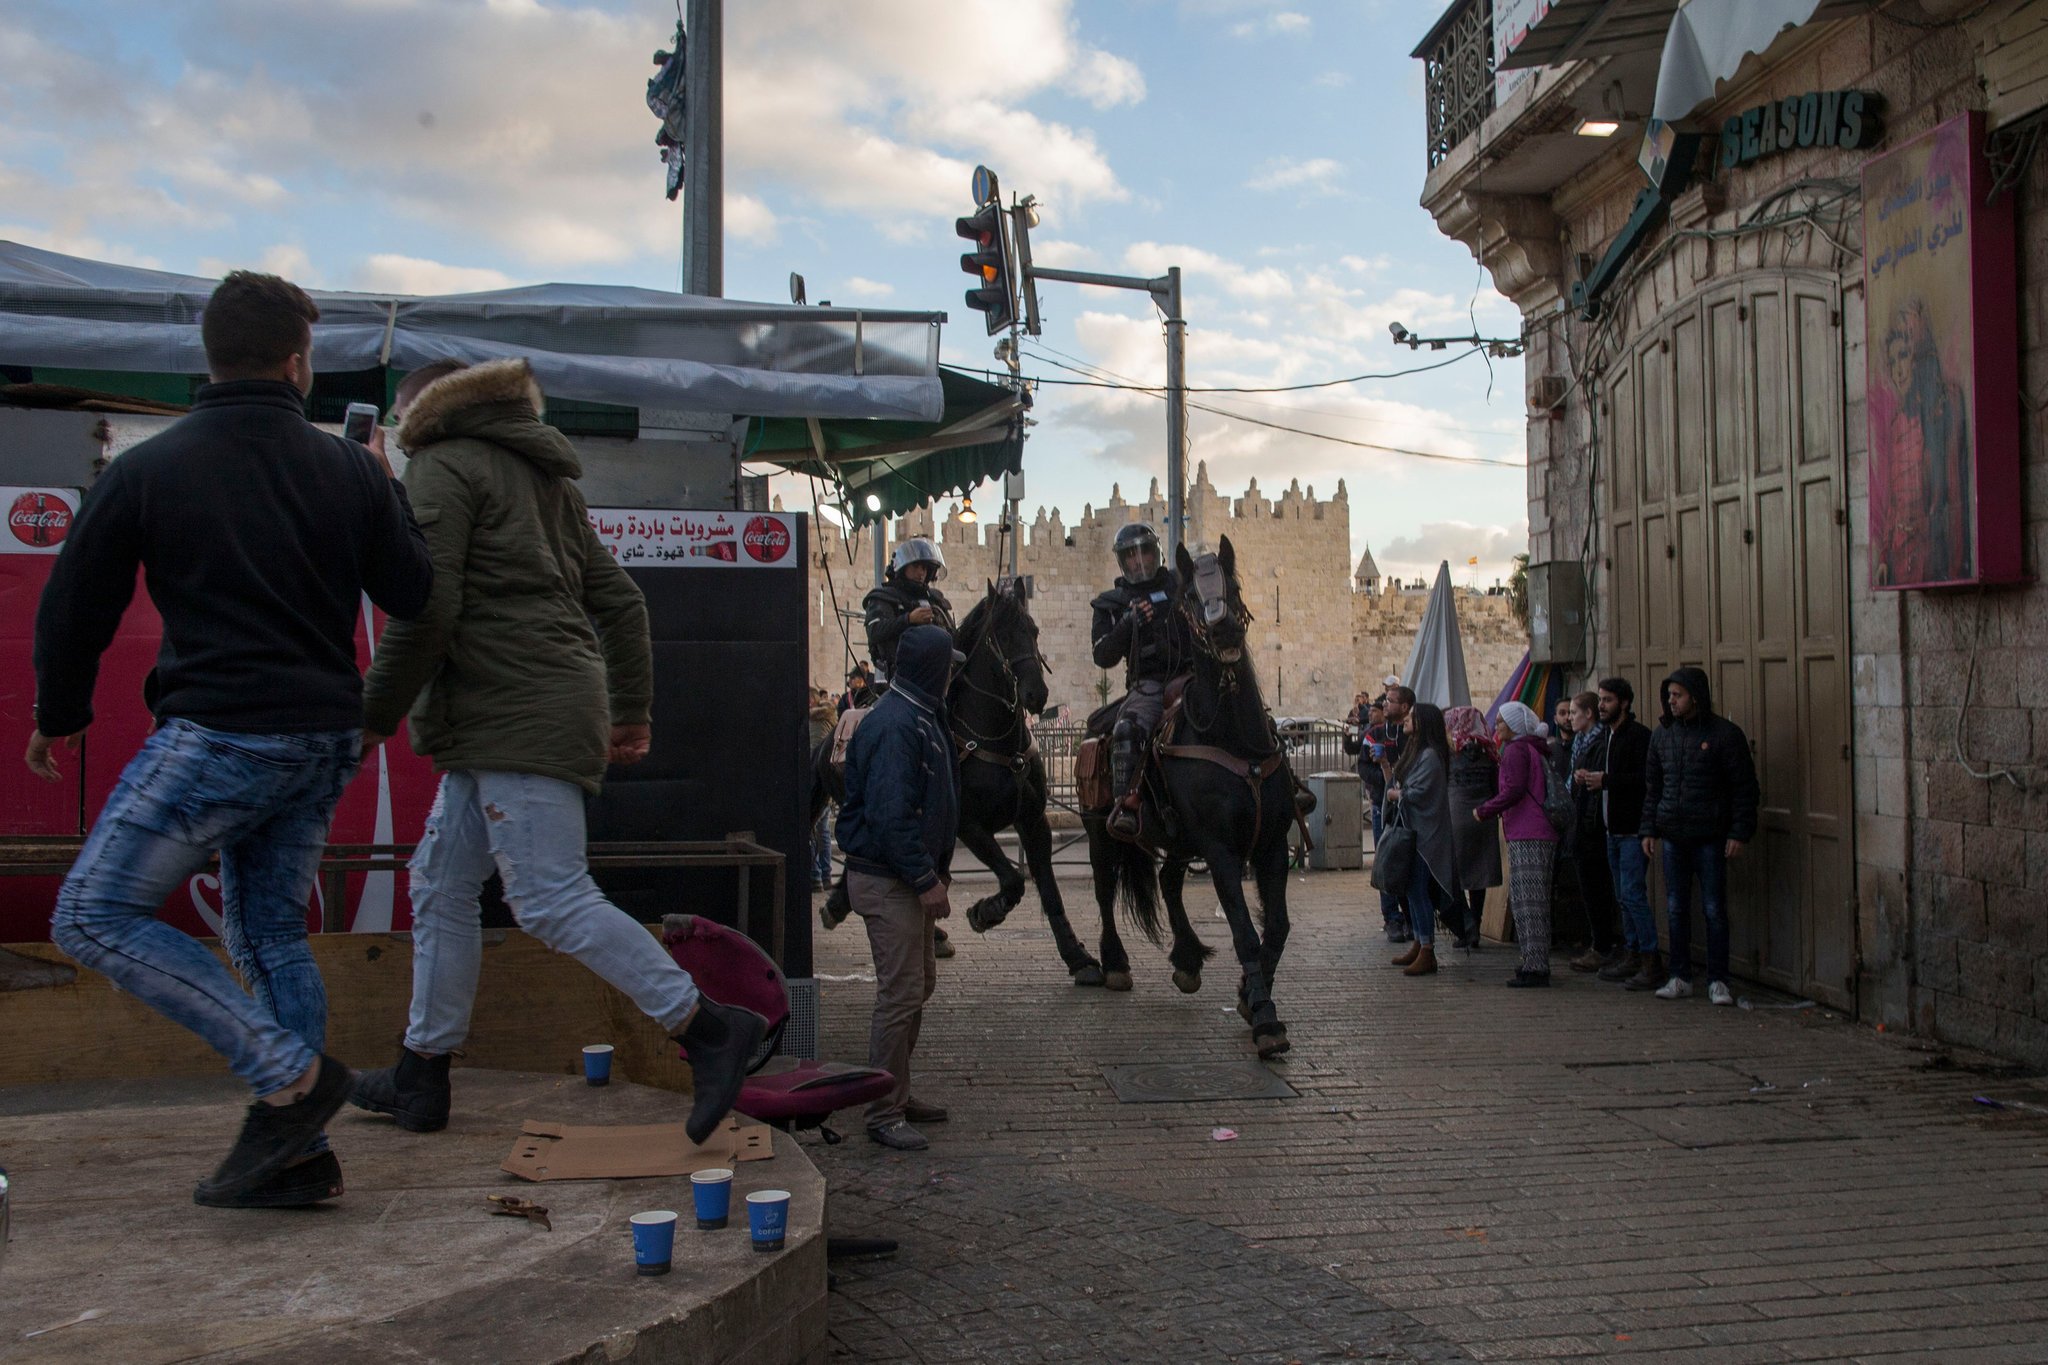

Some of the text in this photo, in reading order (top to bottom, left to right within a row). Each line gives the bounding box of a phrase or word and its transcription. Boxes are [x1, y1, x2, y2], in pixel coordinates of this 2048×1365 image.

[1721, 90, 1864, 169] SEASONS
[628, 516, 665, 541] باردة
[670, 513, 735, 541] مشروبات
[622, 543, 645, 562] شاي
[656, 545, 685, 561] قهوة
[758, 1227, 783, 1236] COFFEE
